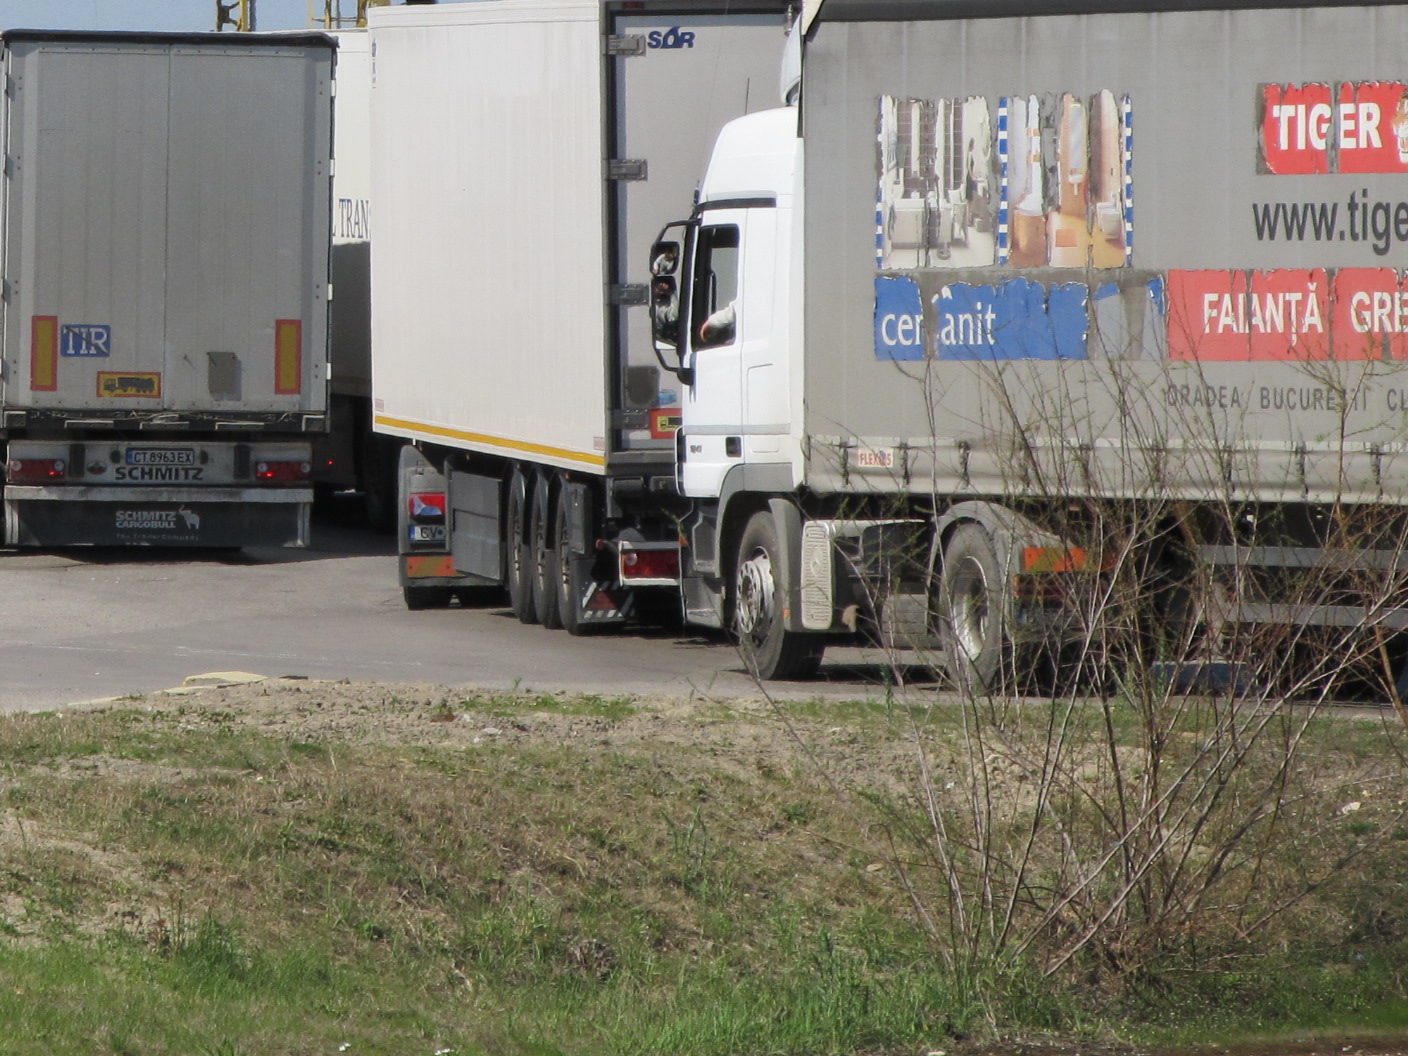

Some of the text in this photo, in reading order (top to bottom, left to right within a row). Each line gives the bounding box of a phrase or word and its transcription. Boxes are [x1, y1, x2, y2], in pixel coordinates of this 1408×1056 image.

[1273, 102, 1383, 150] TIGER
[339, 198, 371, 239] TRAN
[63, 326, 109, 354] TIR
[115, 466, 203, 481] SCHMITZ
[115, 510, 177, 521] SCHMITZ
[115, 520, 176, 529] CARGOBULL
